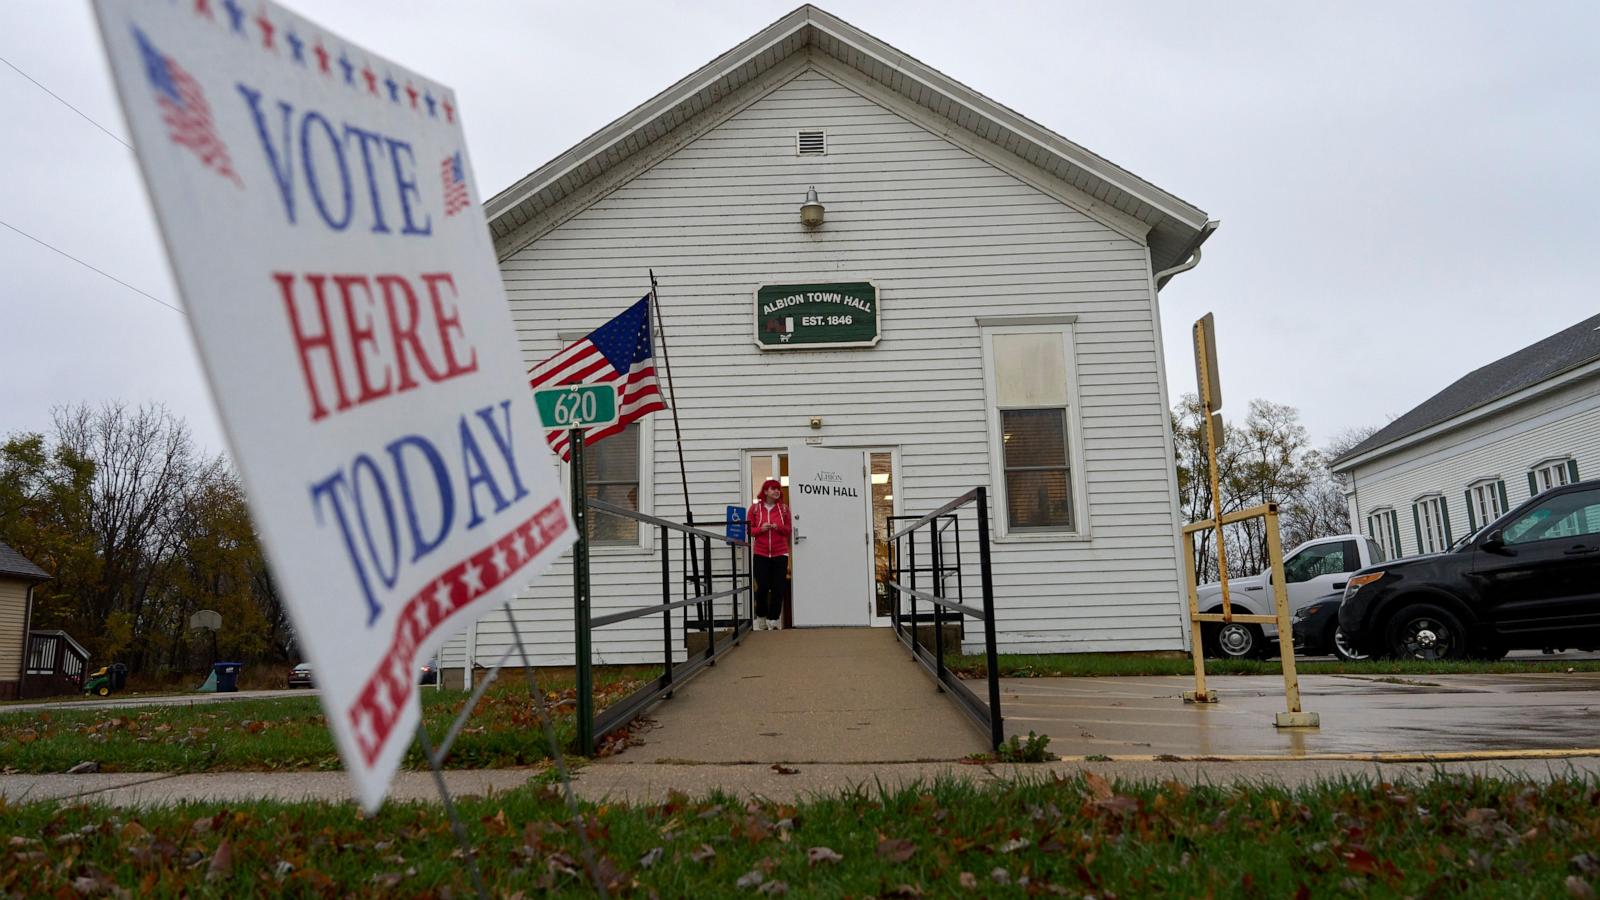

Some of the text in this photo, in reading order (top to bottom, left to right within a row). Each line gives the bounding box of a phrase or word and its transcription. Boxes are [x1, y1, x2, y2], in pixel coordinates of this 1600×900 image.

[235, 82, 432, 237] VOTE
[763, 292, 871, 315] ALBION TOWN HALL
[802, 315, 852, 326] EST. 1846
[271, 272, 478, 423] HERE
[554, 390, 597, 425] 620
[798, 483, 858, 498] TOWN HALL
[308, 399, 530, 628] TODAY
